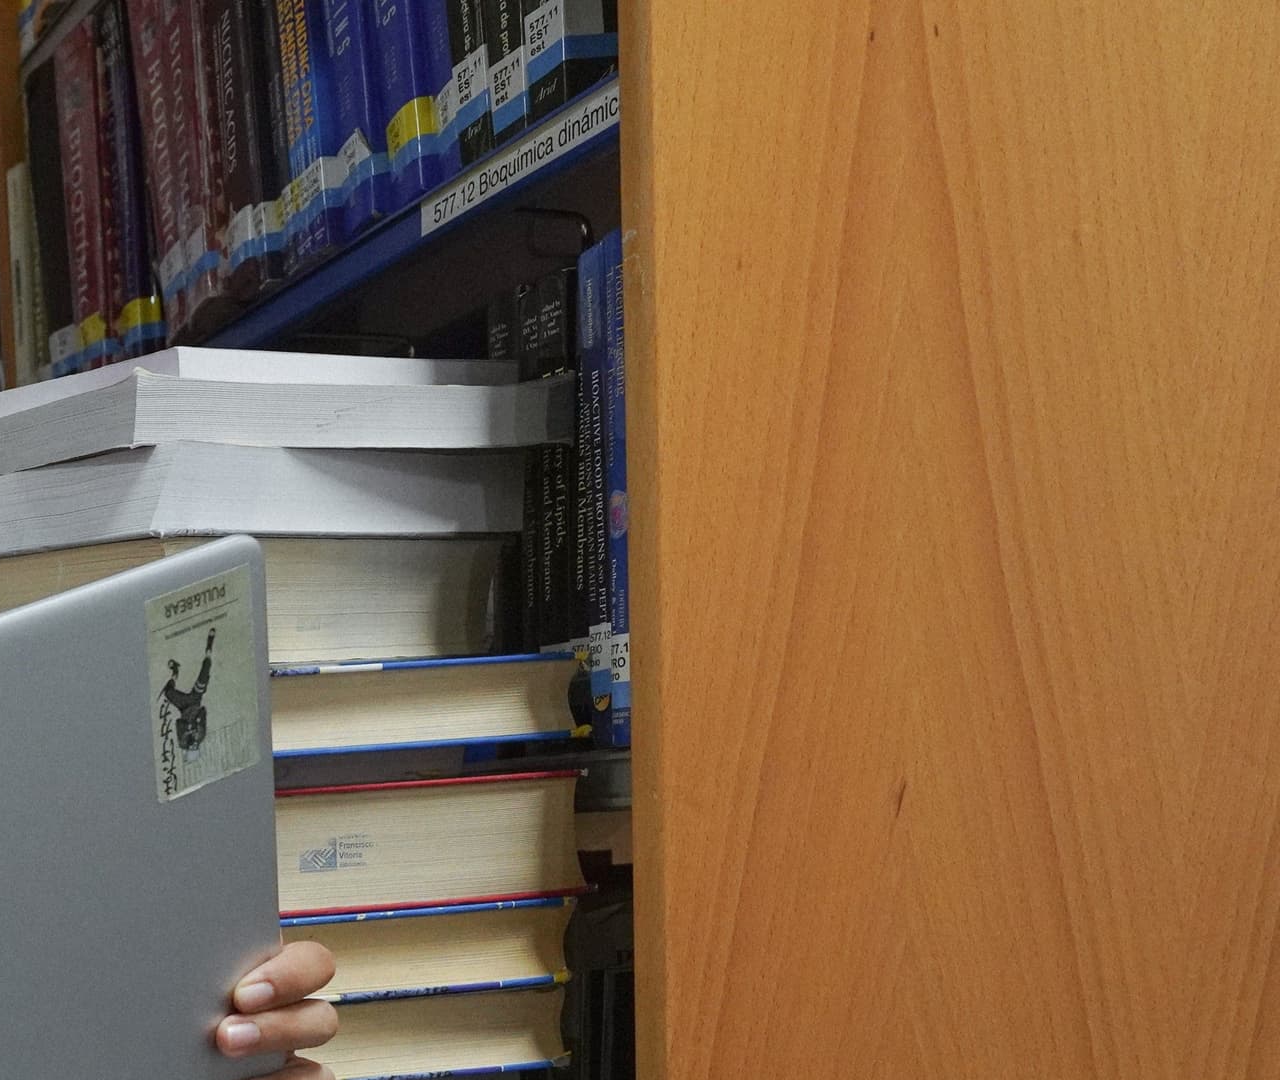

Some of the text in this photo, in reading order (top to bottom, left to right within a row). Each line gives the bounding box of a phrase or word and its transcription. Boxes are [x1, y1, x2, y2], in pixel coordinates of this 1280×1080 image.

[500, 12, 509, 30] de
[529, 6, 559, 31] 577.11
[530, 24, 549, 45] EST
[530, 41, 546, 56] est
[493, 57, 520, 84] 577.11
[220, 9, 238, 174] NUCLEIC ACIDS
[458, 75, 474, 94] EST
[494, 75, 511, 95] EST
[459, 91, 472, 105] est
[495, 93, 509, 106] est
[433, 96, 619, 223] 577.12 Bioquímica dinámic
[592, 369, 600, 447] BIOACTIVE
[578, 462, 586, 492] and
[594, 449, 603, 493] FOOD
[596, 493, 606, 561] PROTEINS
[543, 511, 555, 601] Membranes
[576, 499, 587, 591] Membranes
[164, 583, 227, 619] PULL&BEAR
[590, 630, 611, 643] 577.12
[612, 657, 626, 668] RO
[338, 841, 375, 850] Francisco
